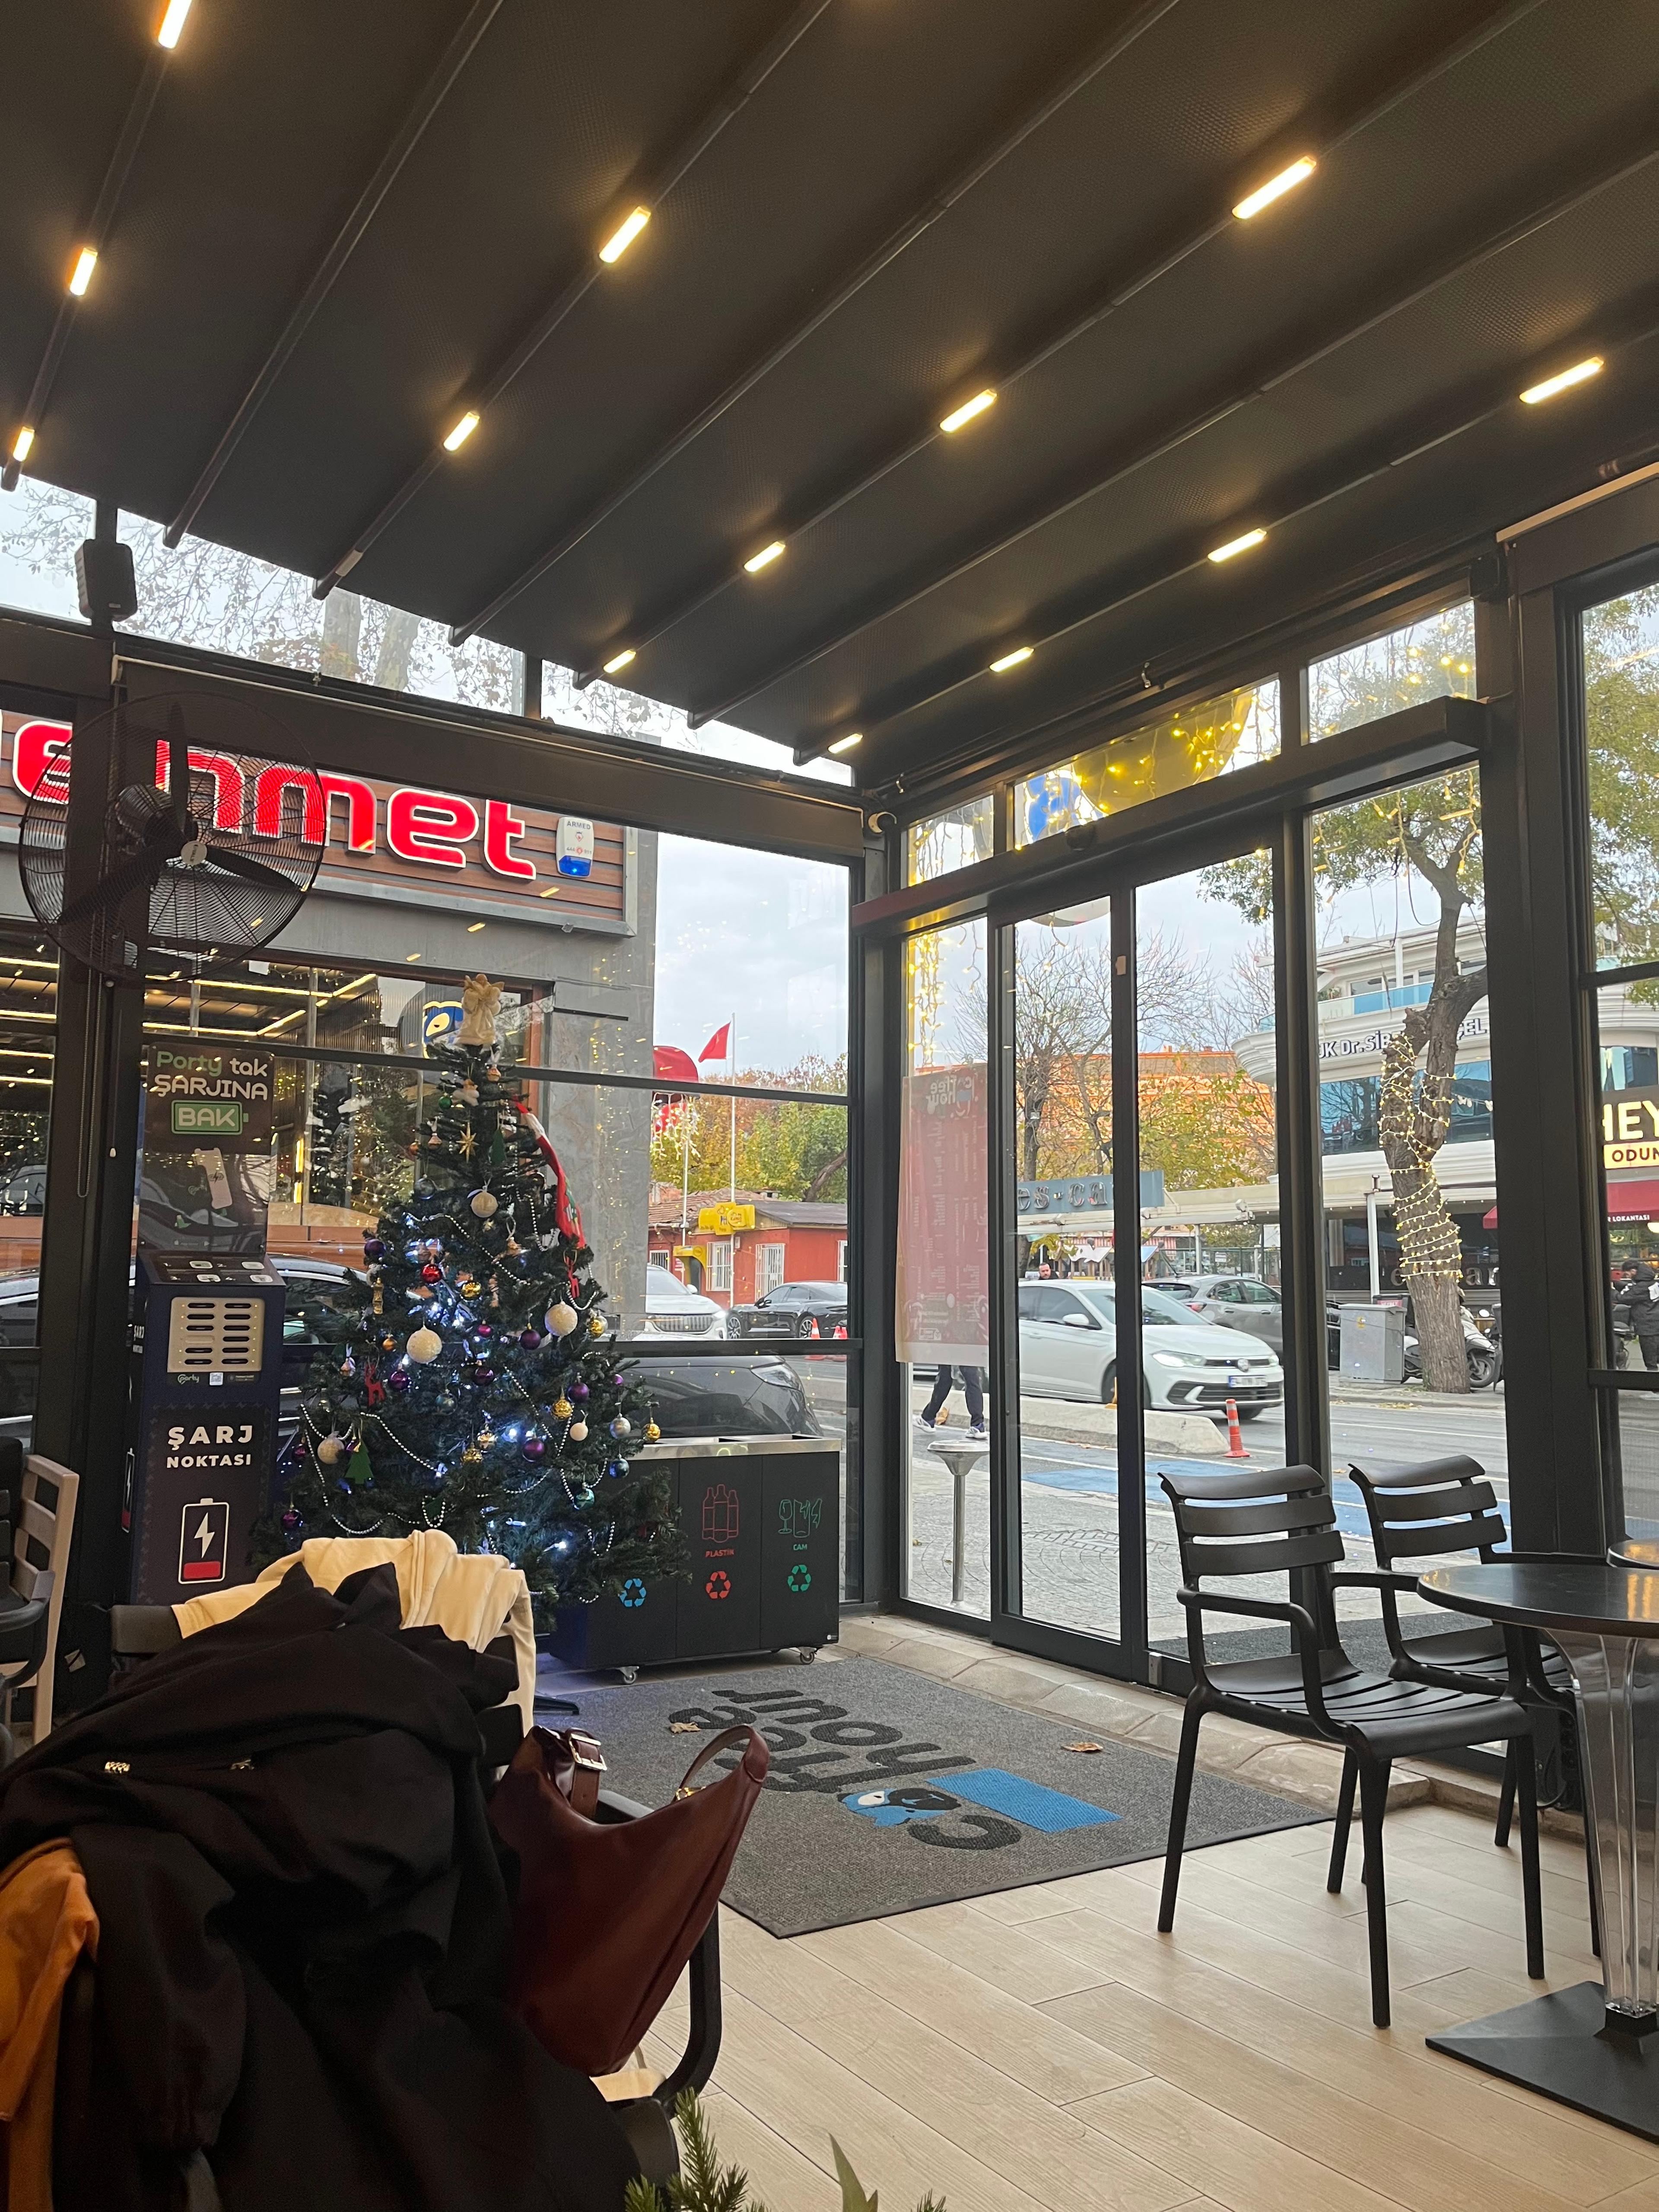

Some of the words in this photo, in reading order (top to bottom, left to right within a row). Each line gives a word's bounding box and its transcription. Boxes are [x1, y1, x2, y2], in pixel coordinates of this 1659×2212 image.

[567, 821, 591, 830] ARMED
[157, 1051, 222, 1077] Porty
[229, 1058, 268, 1077] tak
[154, 1074, 268, 1100] ŞARJINA
[178, 1108, 235, 1127] BAK
[168, 1425, 253, 1451] ŞARJ
[166, 1454, 251, 1468] NOKTASI
